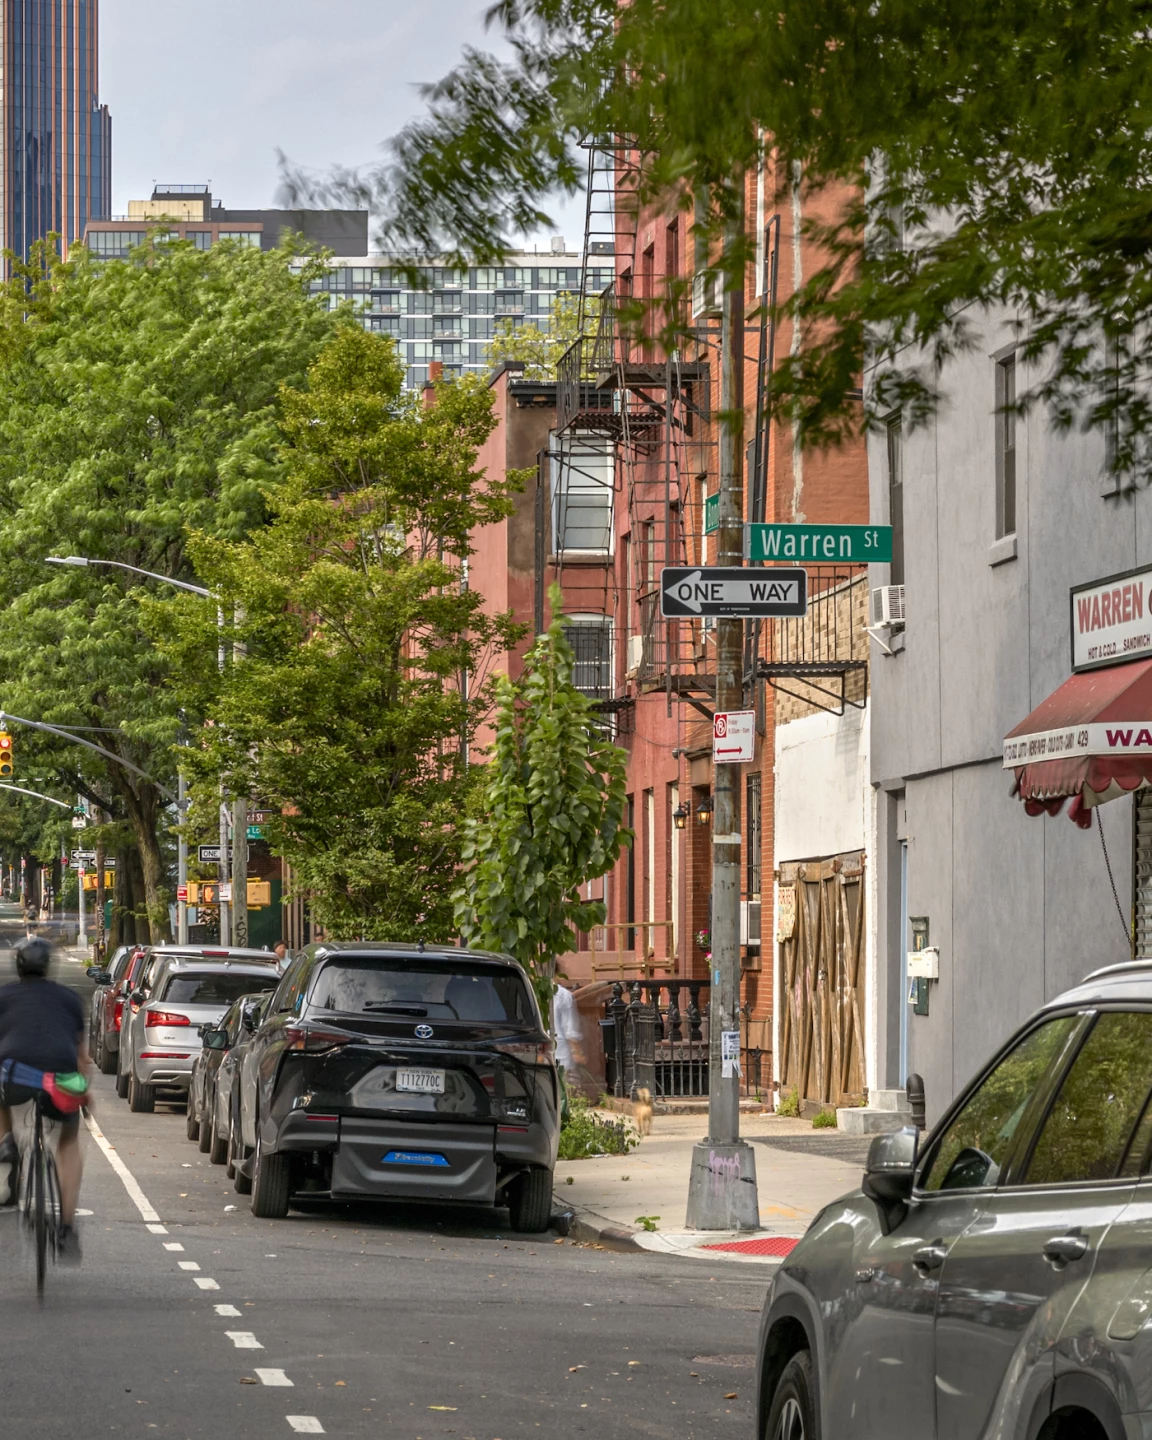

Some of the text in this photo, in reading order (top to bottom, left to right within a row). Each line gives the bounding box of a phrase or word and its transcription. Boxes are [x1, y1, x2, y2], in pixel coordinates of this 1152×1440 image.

[761, 529, 879, 557] Warren St
[678, 583, 793, 601] ONE WAY
[1077, 581, 1143, 634] WARREN
[1088, 646, 1098, 660] HOT
[1103, 642, 1117, 657] COLD
[1077, 730, 1088, 748] 429
[203, 850, 219, 858] ONE
[401, 1073, 440, 1087] T112770C
